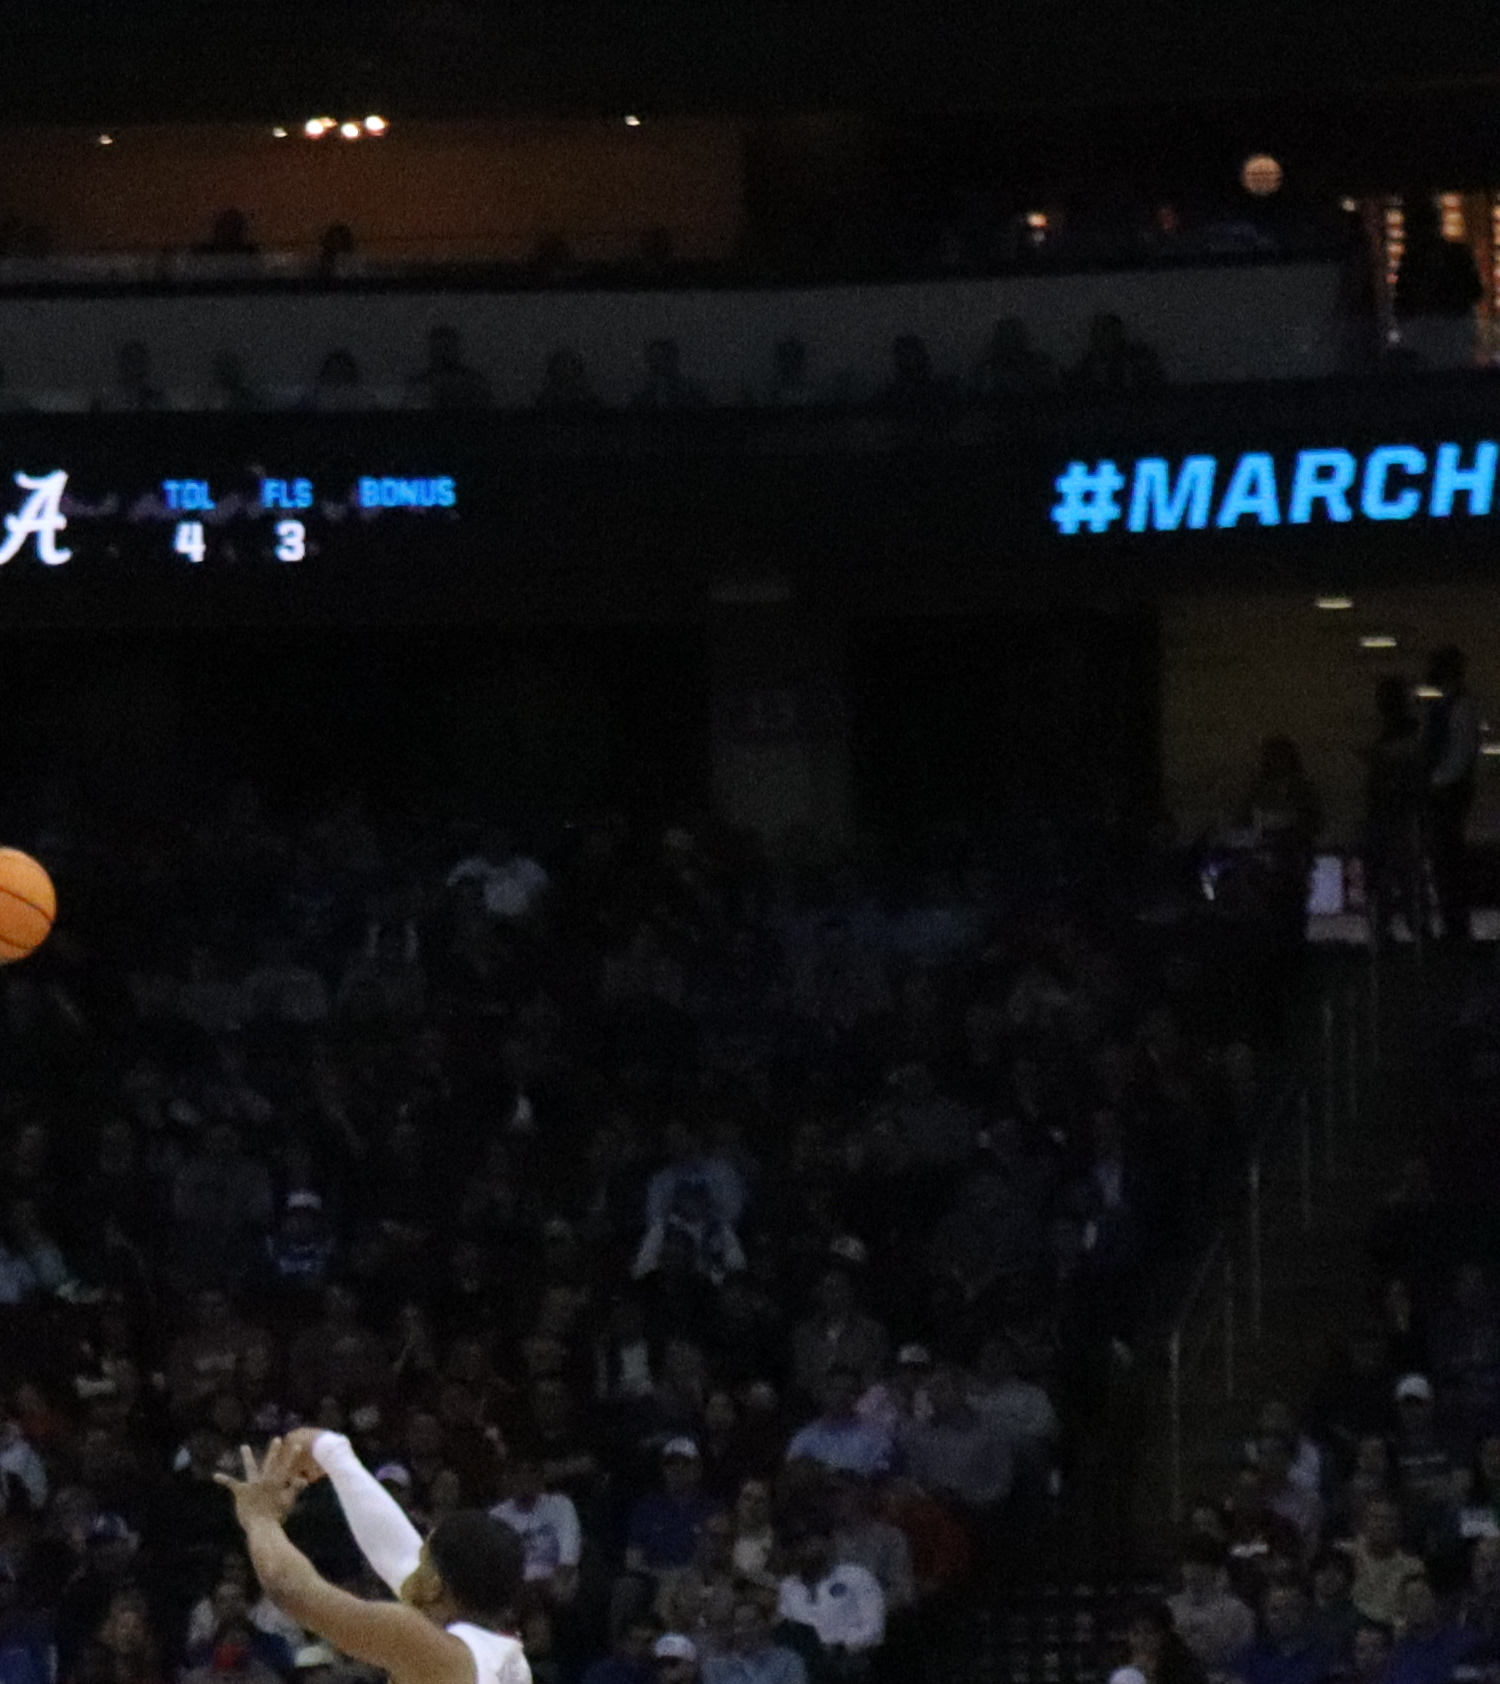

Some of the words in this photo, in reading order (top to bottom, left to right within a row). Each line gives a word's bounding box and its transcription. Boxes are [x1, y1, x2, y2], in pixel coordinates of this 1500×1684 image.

[163, 478, 216, 510] TOL
[261, 477, 314, 510] FLS
[357, 475, 457, 508] BONUS
[1051, 439, 1500, 535] #MARCH
[175, 521, 206, 563] 4
[274, 519, 306, 564] 3
